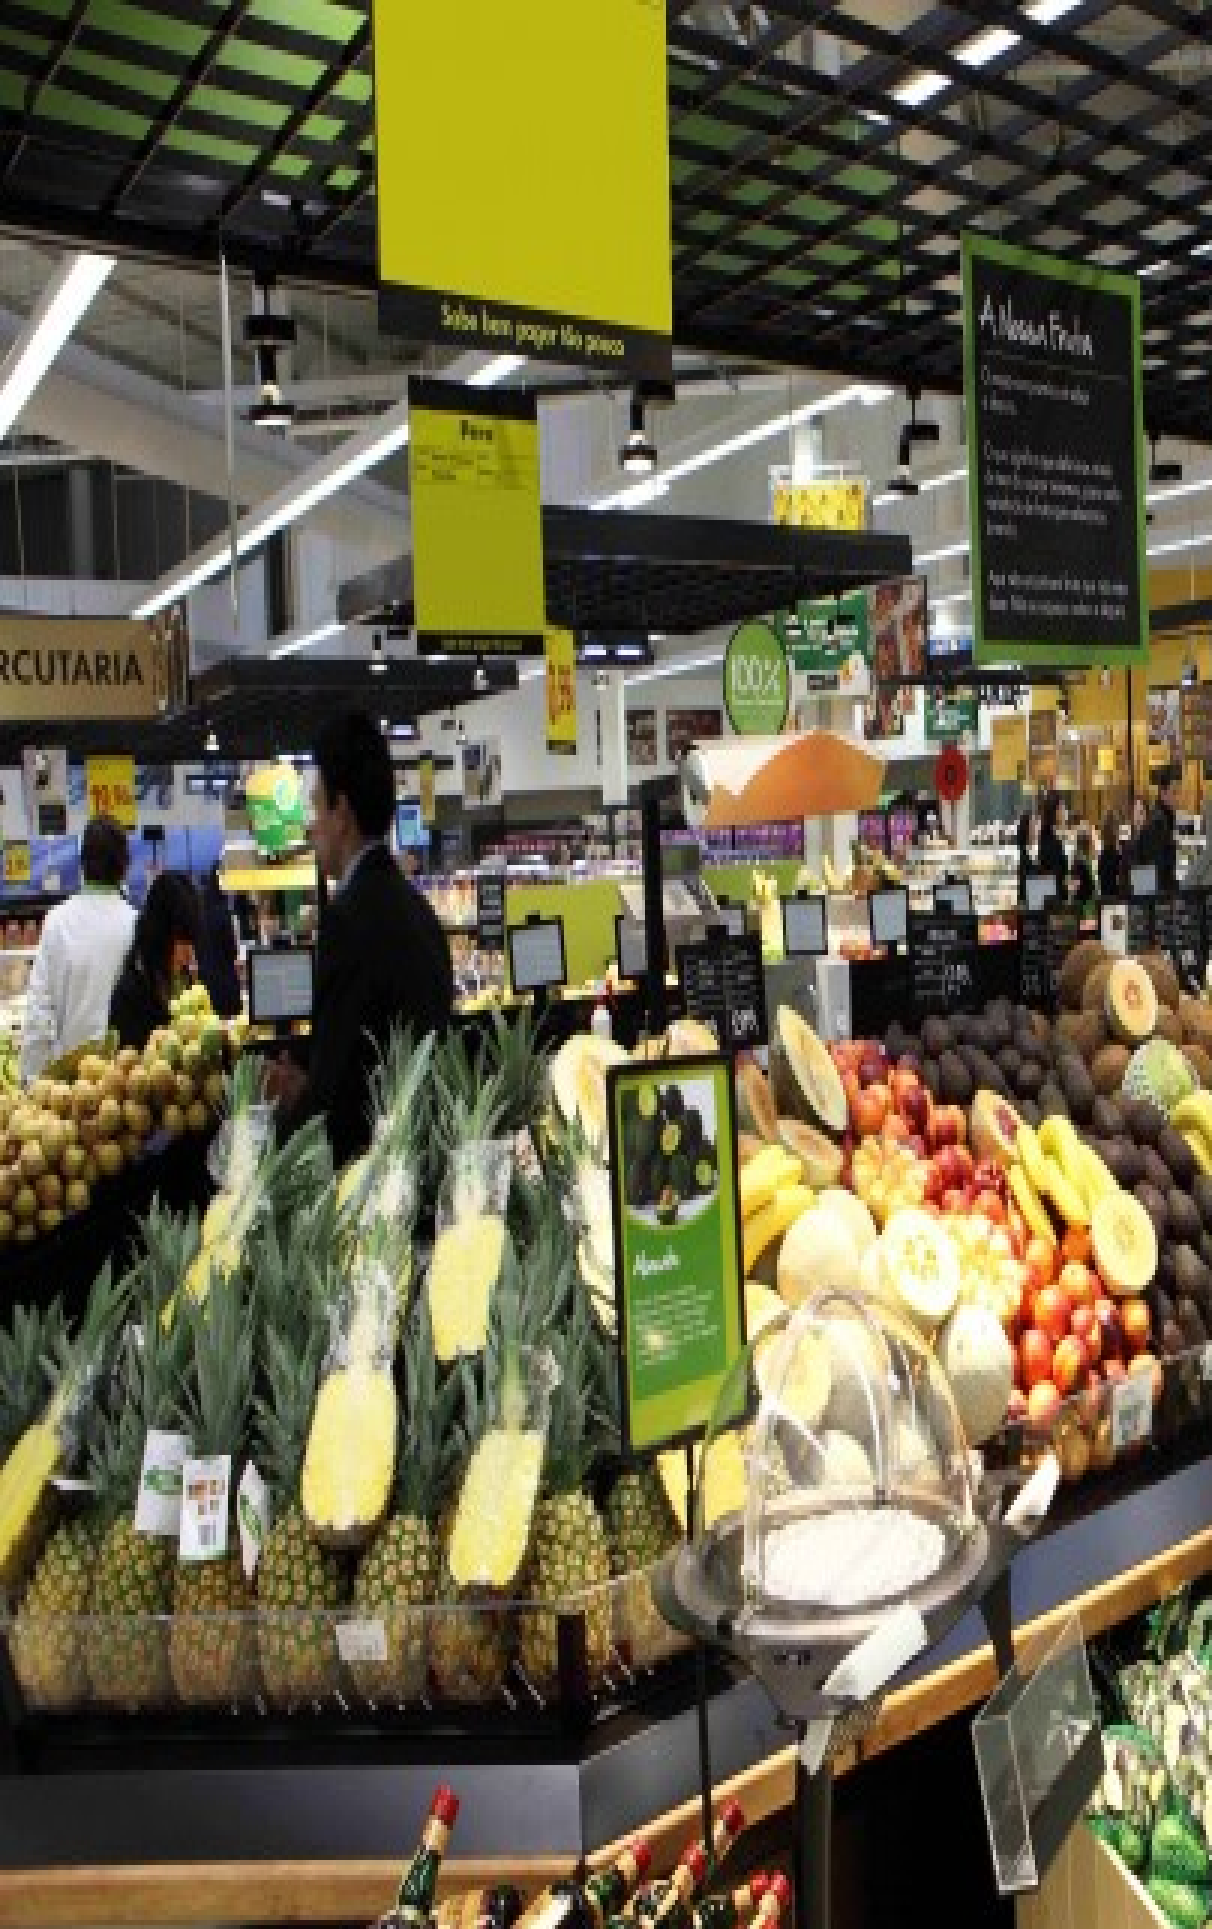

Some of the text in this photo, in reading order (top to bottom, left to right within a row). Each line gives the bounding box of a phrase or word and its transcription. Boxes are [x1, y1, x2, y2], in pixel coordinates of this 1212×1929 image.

[977, 294, 996, 336] A
[0, 649, 144, 686] RCUTARIA
[731, 655, 781, 694] 100%
